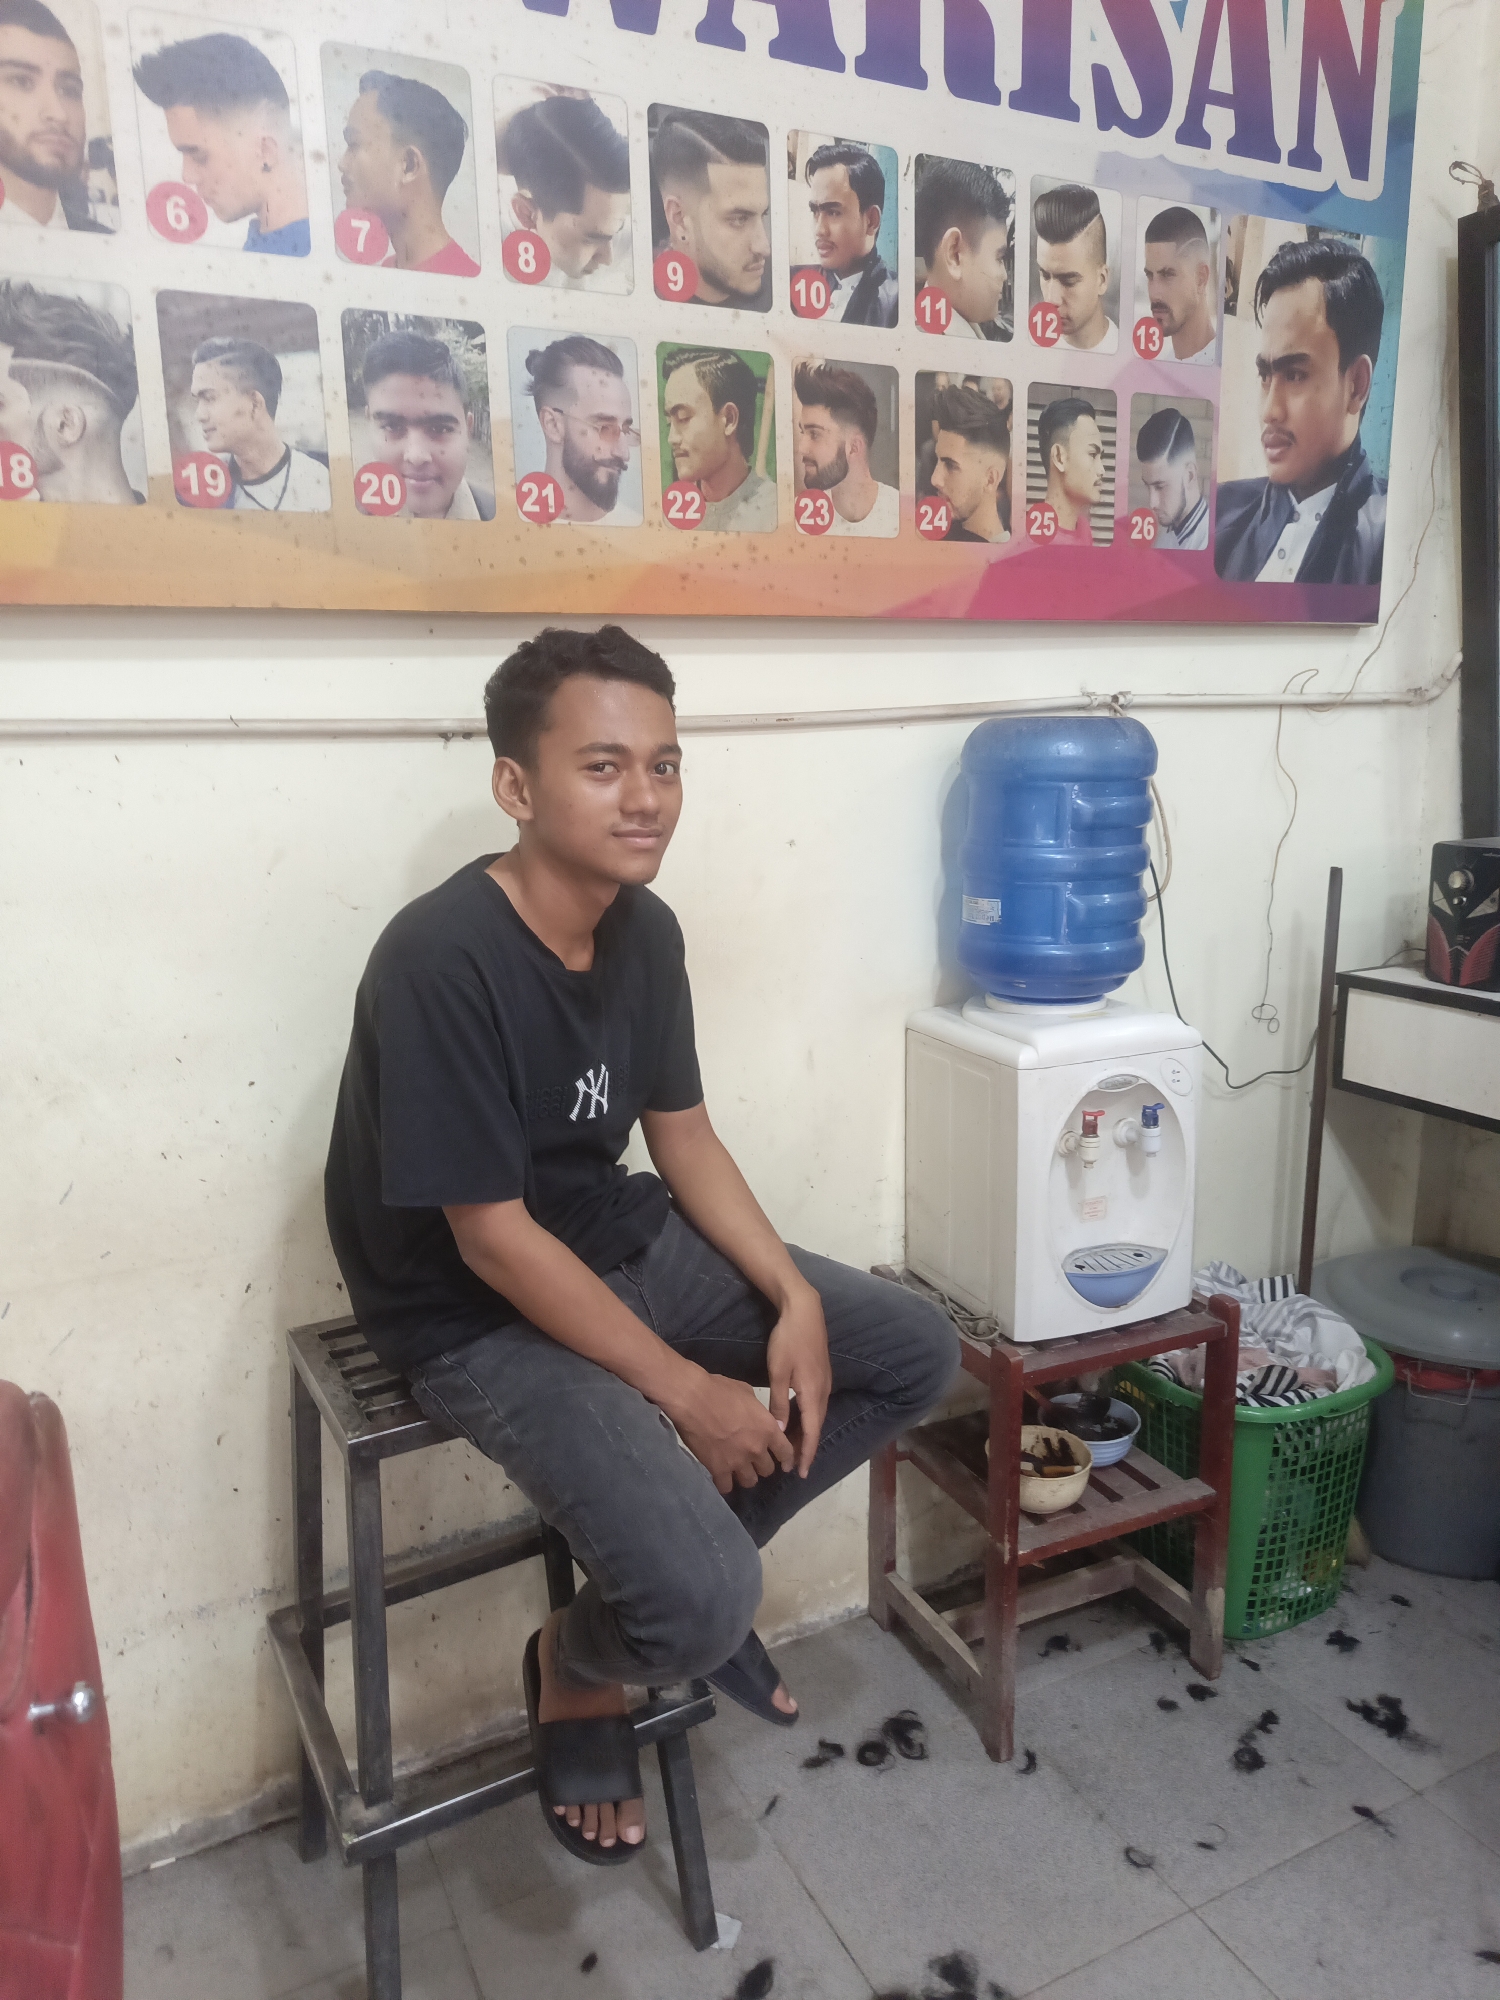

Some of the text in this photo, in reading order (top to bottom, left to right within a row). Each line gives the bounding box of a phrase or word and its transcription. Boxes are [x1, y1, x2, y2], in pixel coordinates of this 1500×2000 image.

[522, 0, 1385, 182] ISAN
[165, 195, 190, 232] 6
[350, 218, 371, 253] 7
[517, 241, 537, 274] 8
[666, 261, 684, 292] 9
[794, 278, 826, 310] 10
[920, 295, 947, 325] 11
[1032, 310, 1058, 339] 12
[1136, 325, 1160, 352] 13
[0, 453, 34, 489] 8
[181, 462, 226, 498] 19
[360, 472, 402, 506] 20
[521, 481, 556, 513] 21
[667, 490, 701, 520] 22
[799, 497, 830, 526] 23
[919, 504, 948, 531] 24
[1029, 510, 1056, 537] 25
[1130, 515, 1155, 541] 26
